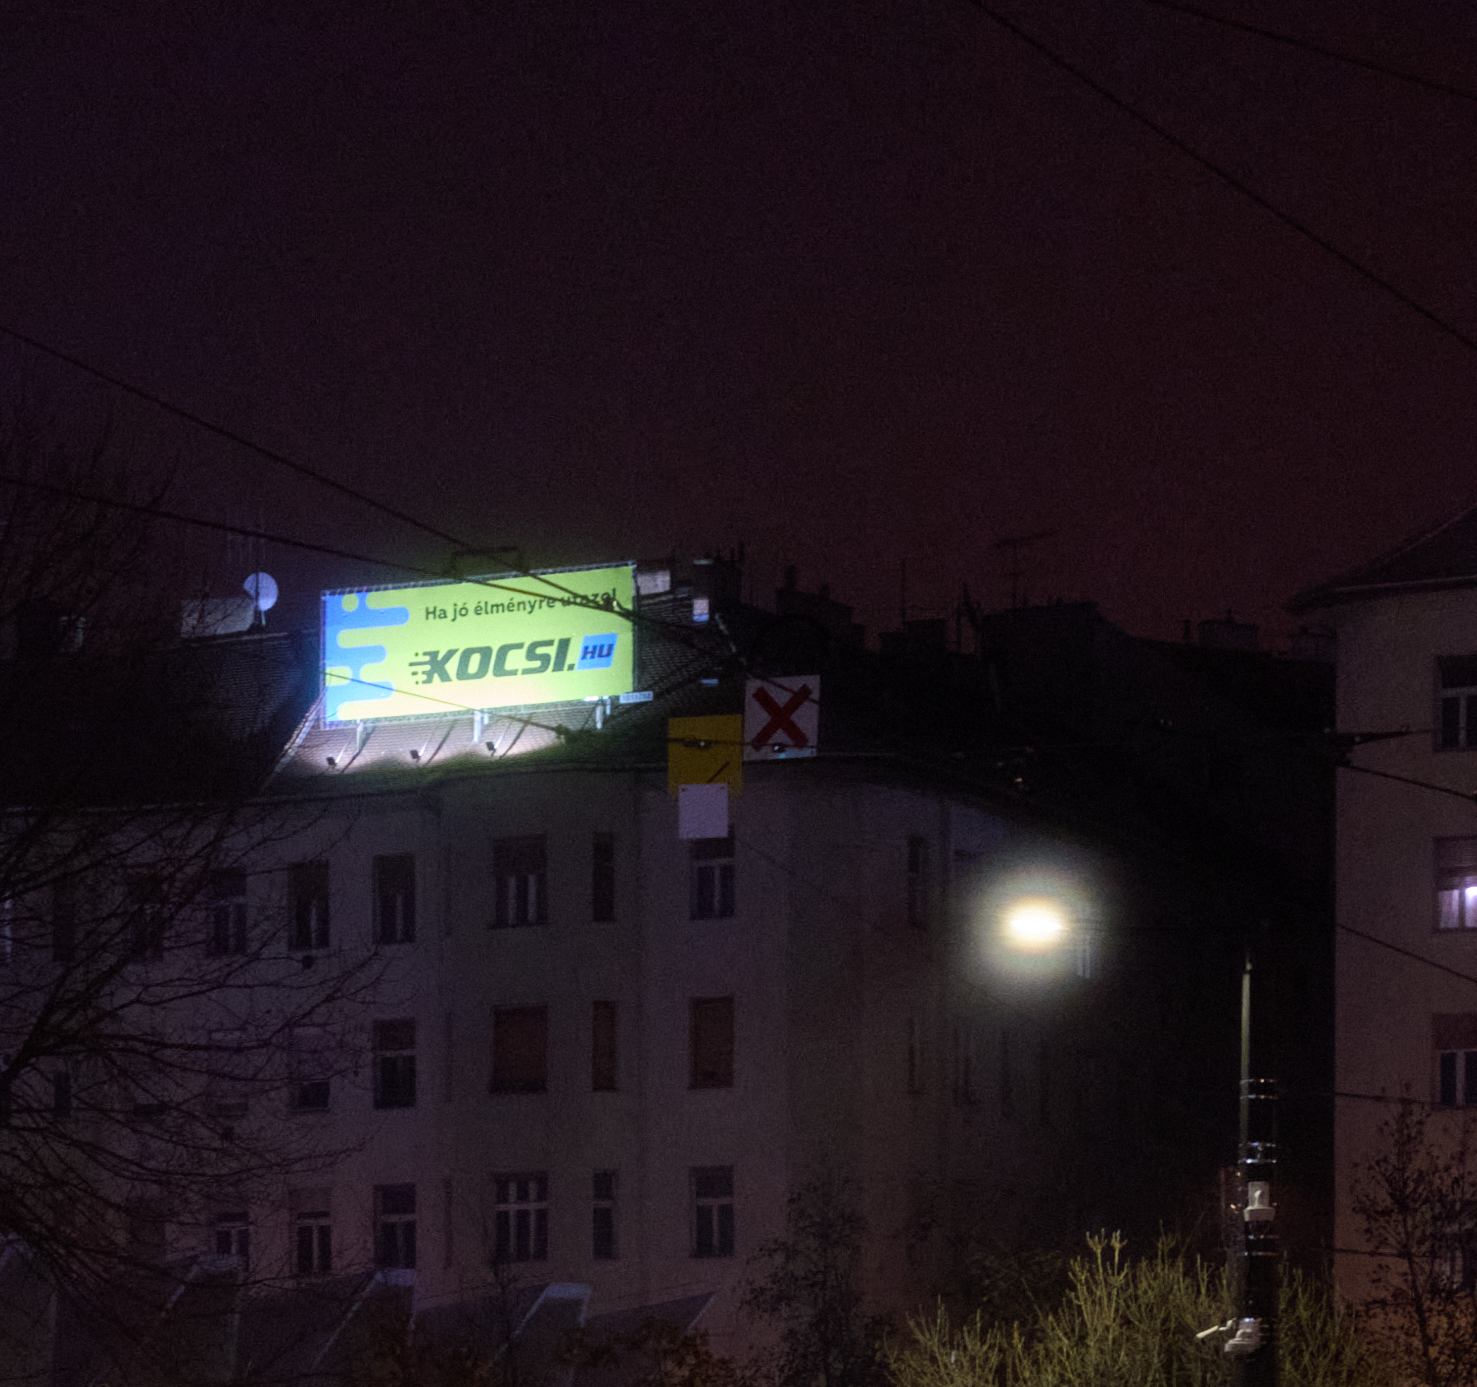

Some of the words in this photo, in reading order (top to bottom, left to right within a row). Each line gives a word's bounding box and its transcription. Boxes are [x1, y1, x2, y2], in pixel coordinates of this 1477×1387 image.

[425, 605, 448, 620] Ha
[451, 602, 469, 622] jó
[474, 596, 555, 615] élményre
[419, 637, 614, 685] KOCSI.HU
